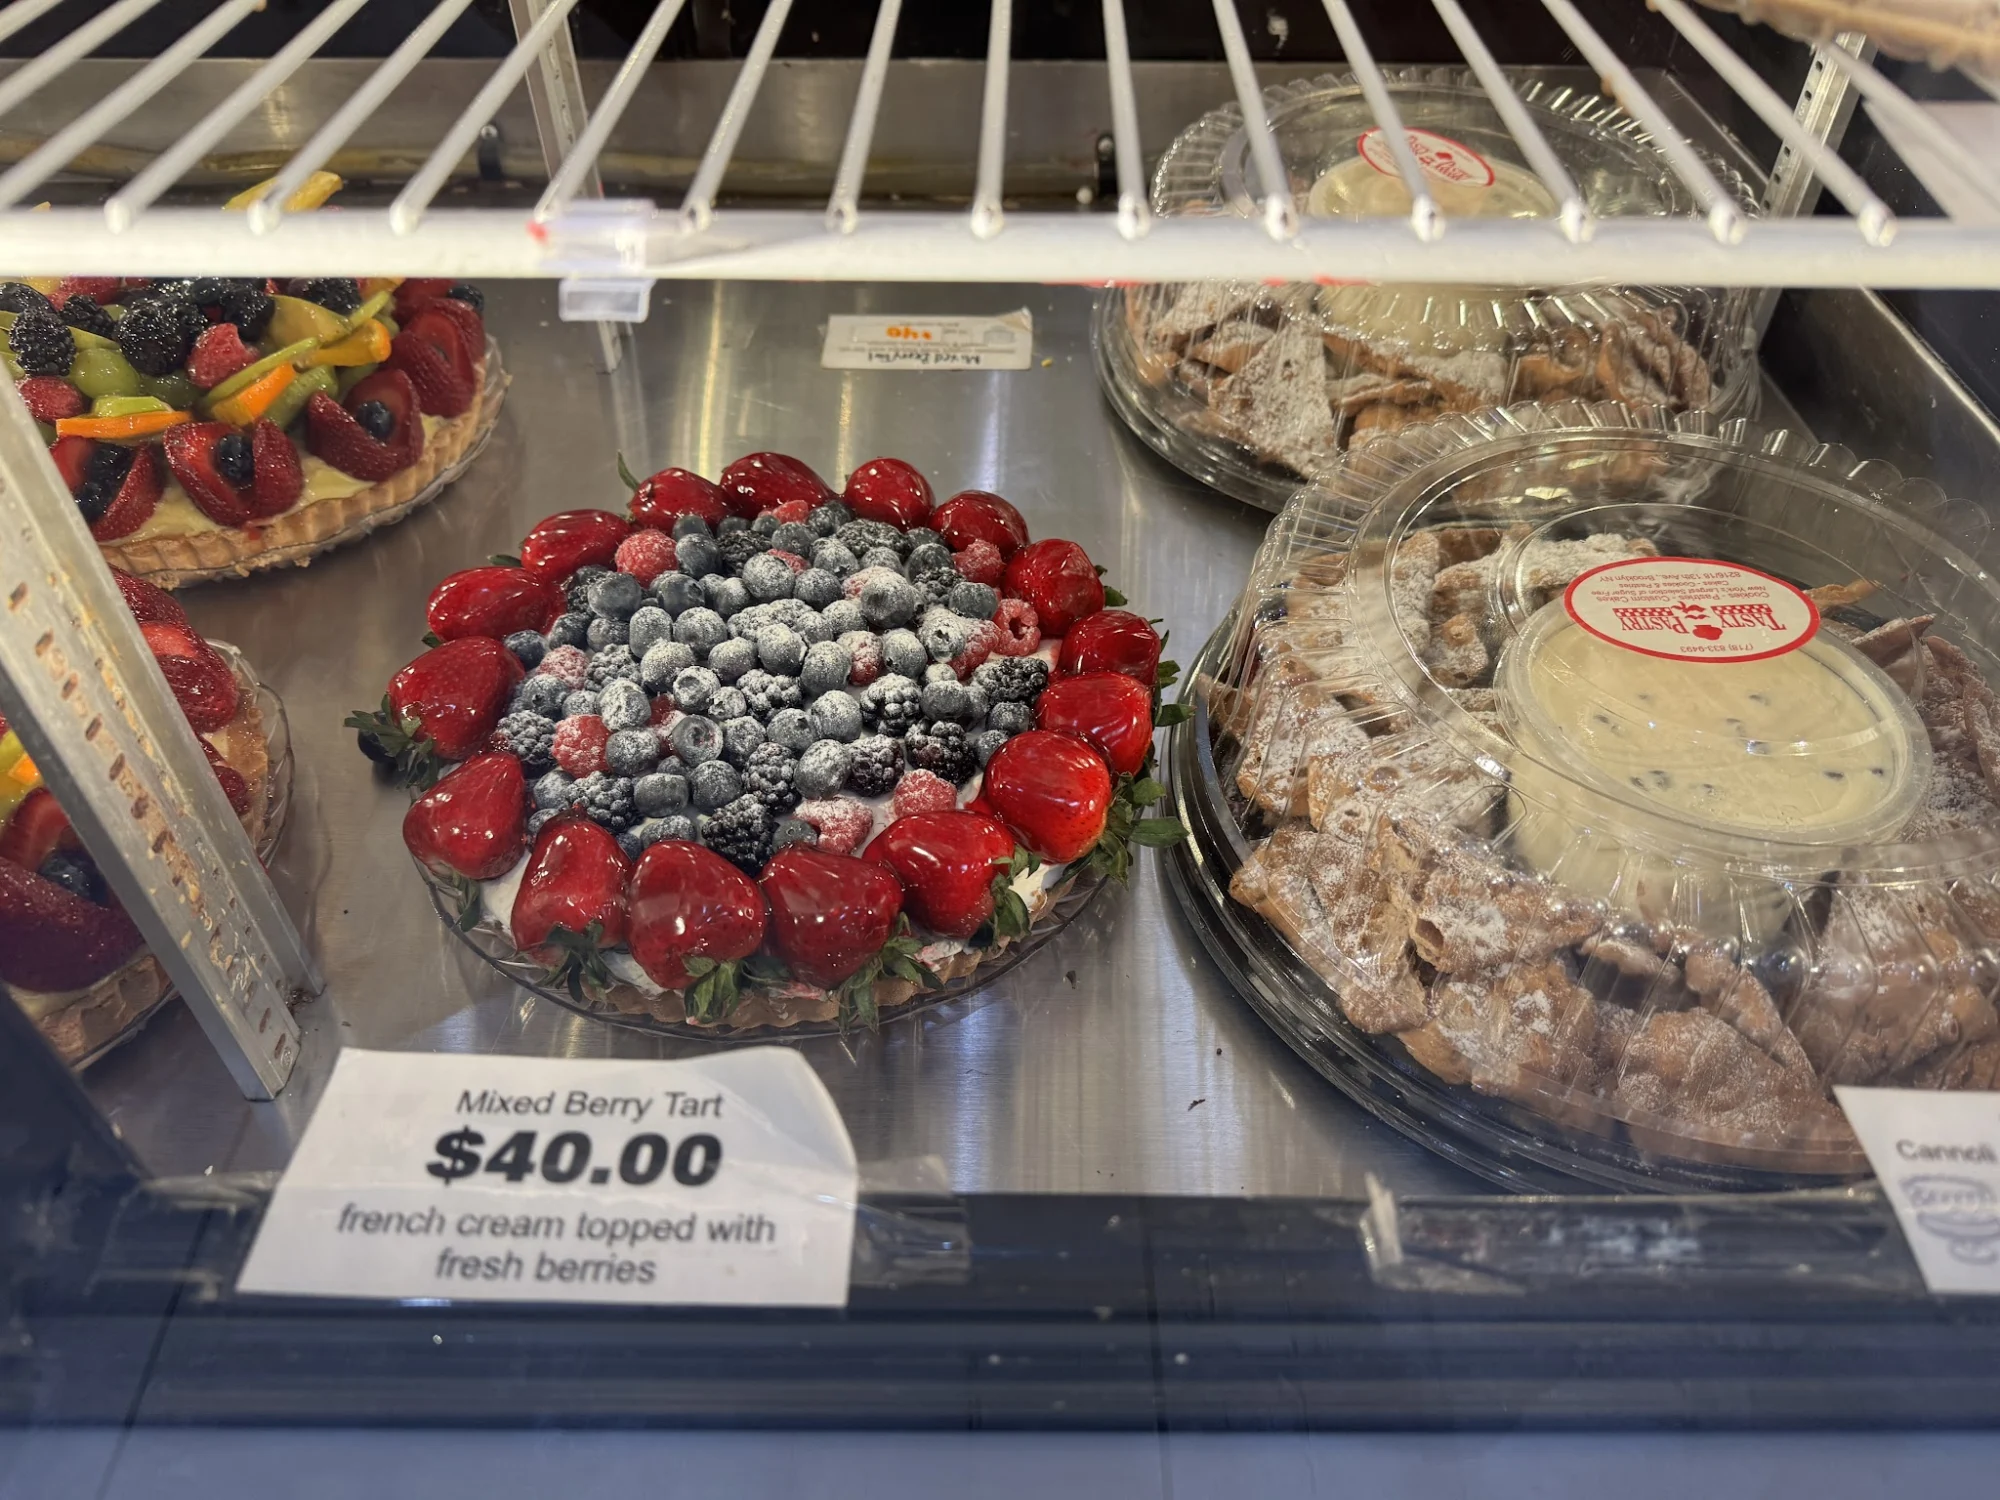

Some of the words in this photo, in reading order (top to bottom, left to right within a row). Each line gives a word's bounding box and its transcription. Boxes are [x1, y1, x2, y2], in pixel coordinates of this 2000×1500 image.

[1678, 593, 1720, 601] Pastries
[1728, 591, 1770, 599] Cookies
[1618, 615, 1690, 634] PASTRY
[1717, 612, 1787, 631] TASTY
[1680, 644, 1726, 653] 833-9493
[1728, 643, 1753, 652] (718)
[456, 1088, 555, 1116] Mixed
[563, 1090, 652, 1123] Berry
[663, 1091, 724, 1119] Tart
[425, 1124, 724, 1187] $40.00
[336, 1203, 446, 1236] french
[456, 1210, 565, 1240] cream
[575, 1213, 697, 1248] topped
[706, 1214, 777, 1242] with
[434, 1246, 524, 1281] fresh
[534, 1251, 658, 1285] berries
